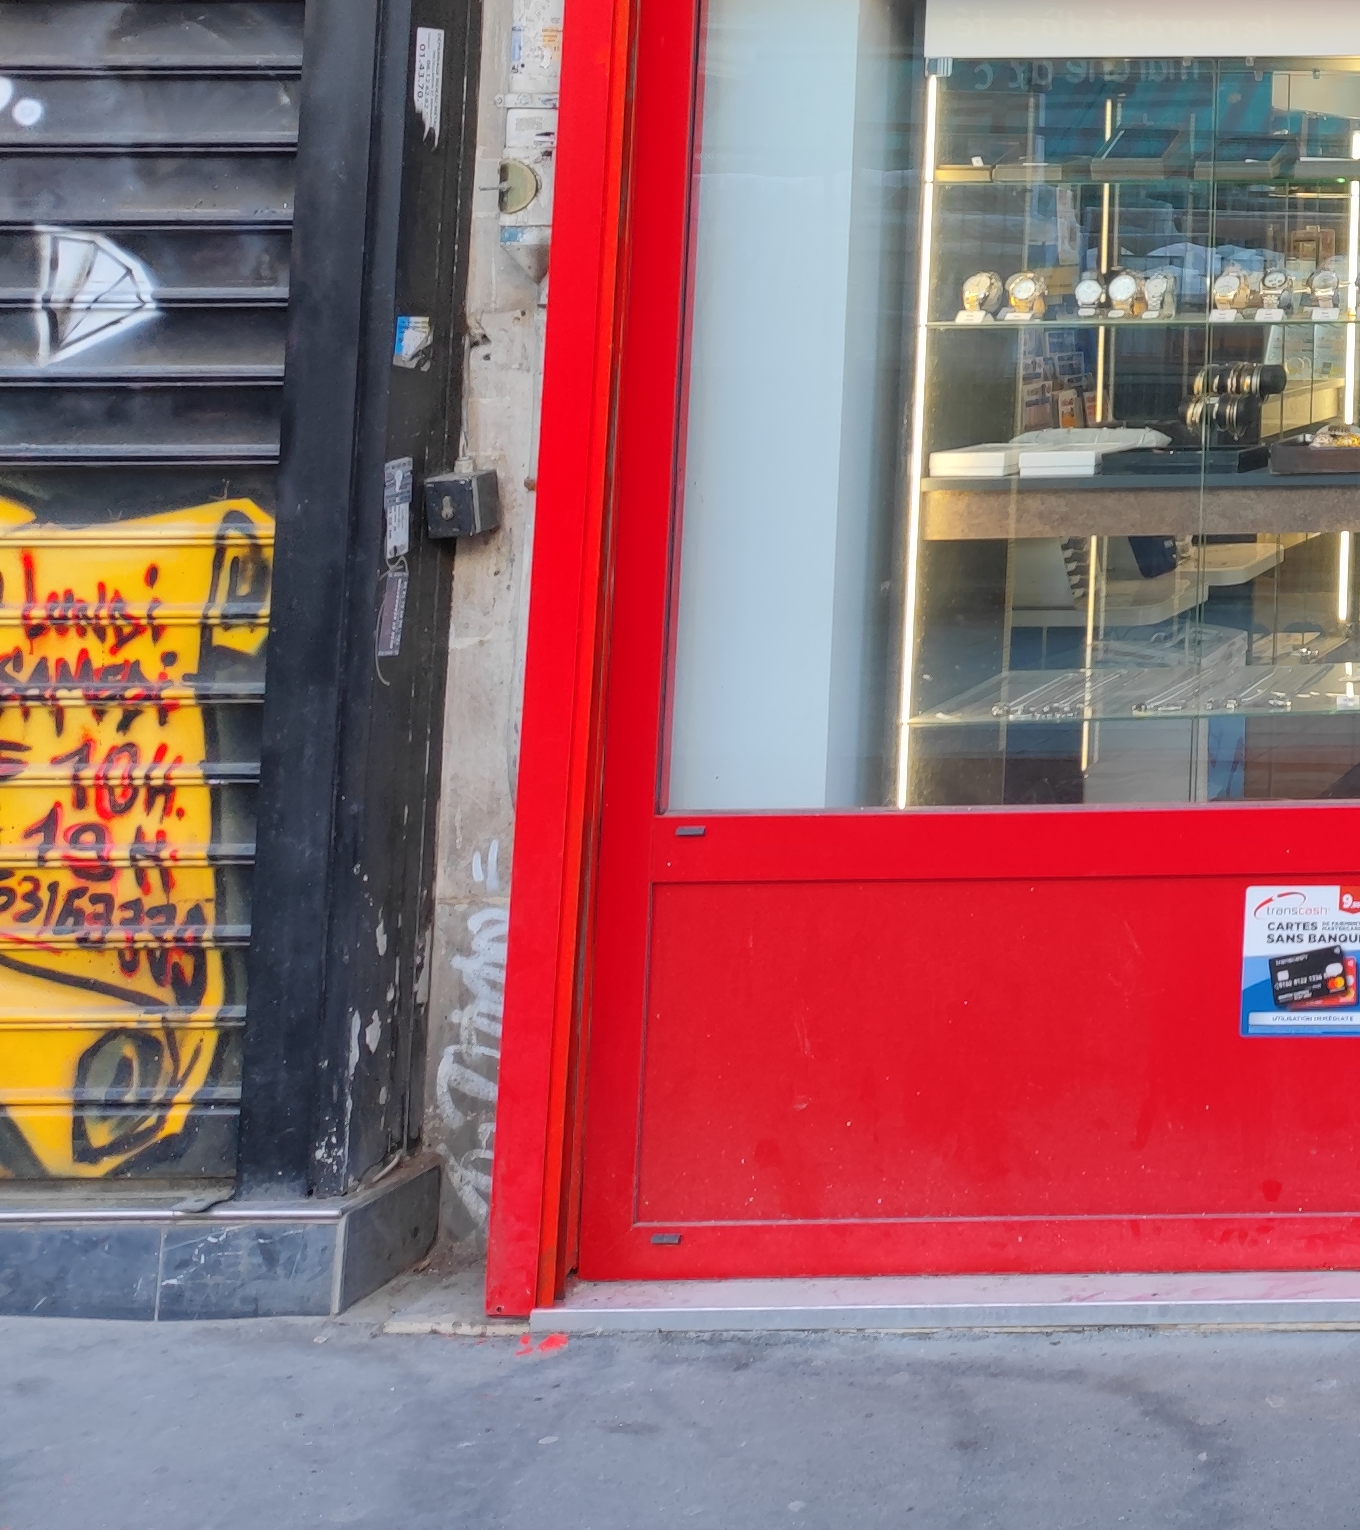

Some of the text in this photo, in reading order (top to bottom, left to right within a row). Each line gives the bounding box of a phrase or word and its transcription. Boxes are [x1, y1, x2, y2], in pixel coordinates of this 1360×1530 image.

[1266, 905, 1328, 916] transcash
[1267, 921, 1318, 932] CARTES
[1266, 933, 1304, 944] SANS
